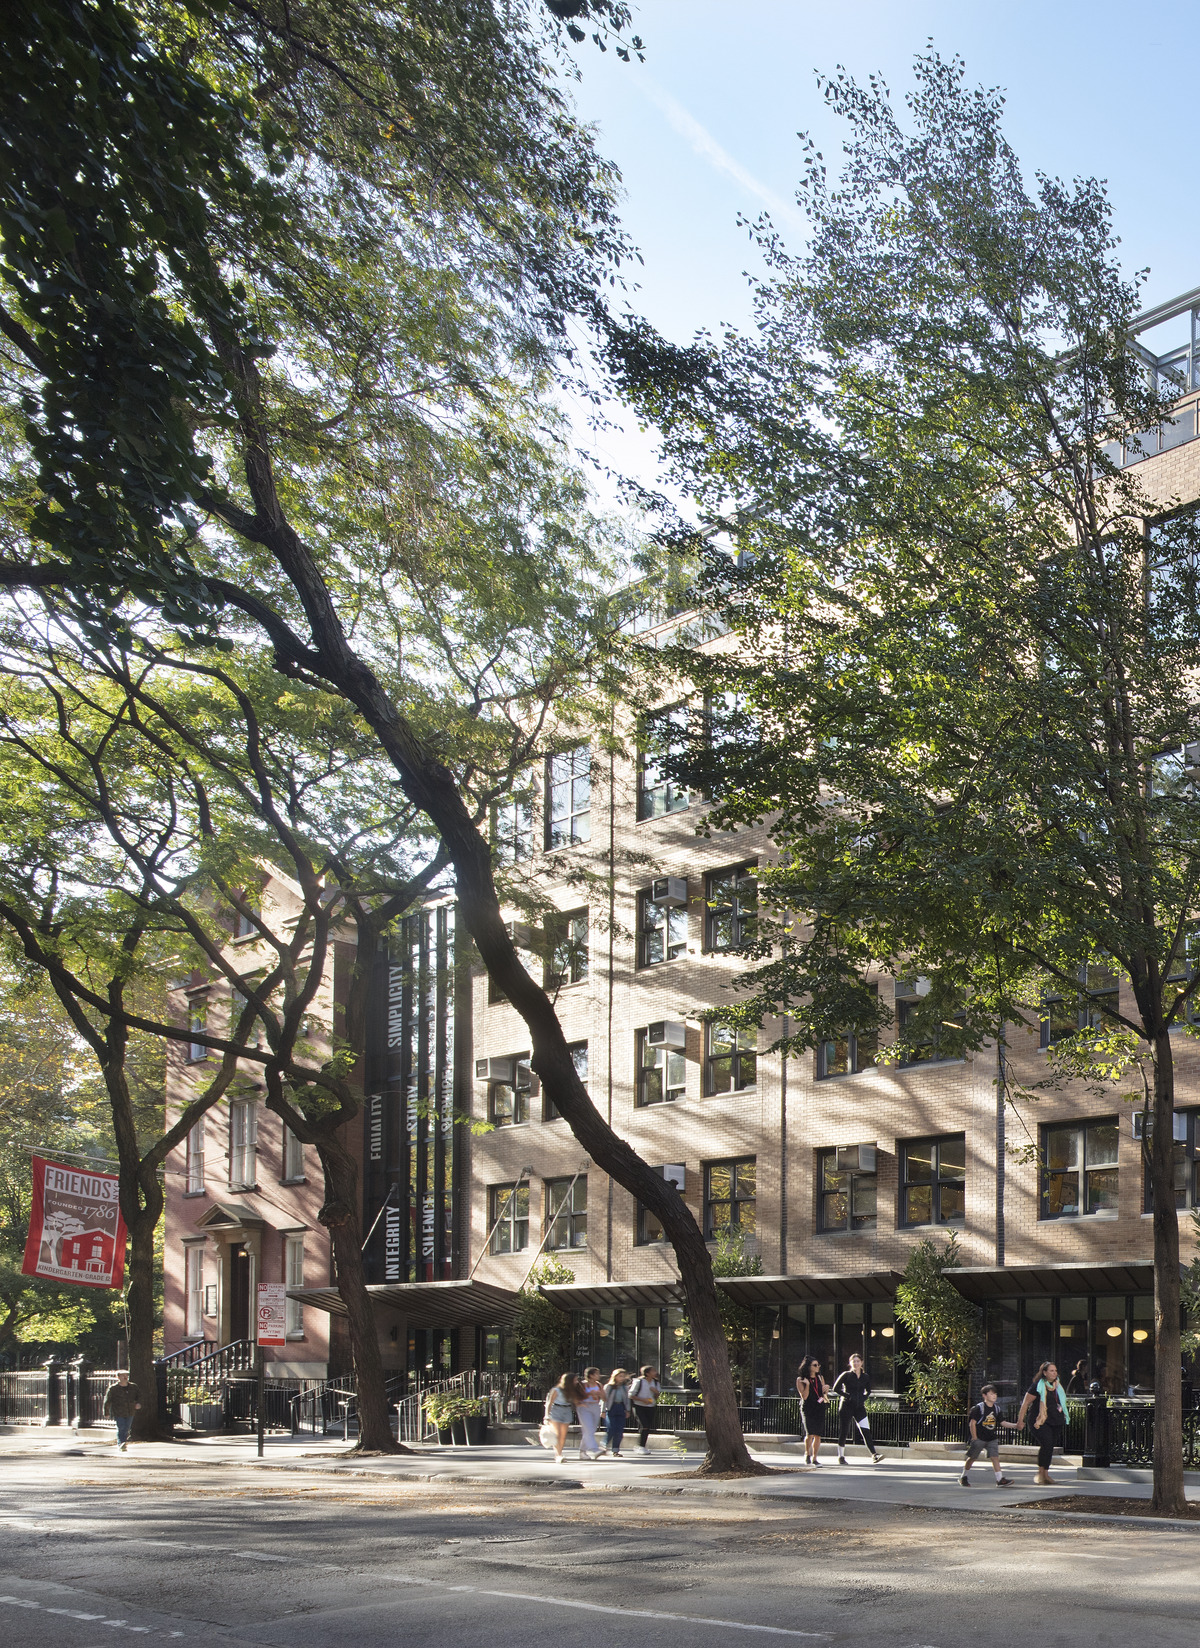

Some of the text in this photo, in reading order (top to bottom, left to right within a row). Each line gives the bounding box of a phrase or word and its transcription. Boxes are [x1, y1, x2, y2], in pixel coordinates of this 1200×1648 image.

[387, 966, 403, 1048] SIMPLICITY
[370, 1094, 382, 1160] EQUALITY
[406, 1085, 418, 1132] STUDY
[440, 1071, 454, 1133] SERVICE
[45, 1168, 111, 1199] FRIENDS
[48, 1199, 116, 1220] FOUNDED 1786
[112, 1181, 120, 1201] NYC
[385, 1206, 400, 1280] INTEGRITY
[422, 1194, 435, 1257] SILENCE
[37, 1264, 105, 1282] KINDERGARTEN-GRADE
